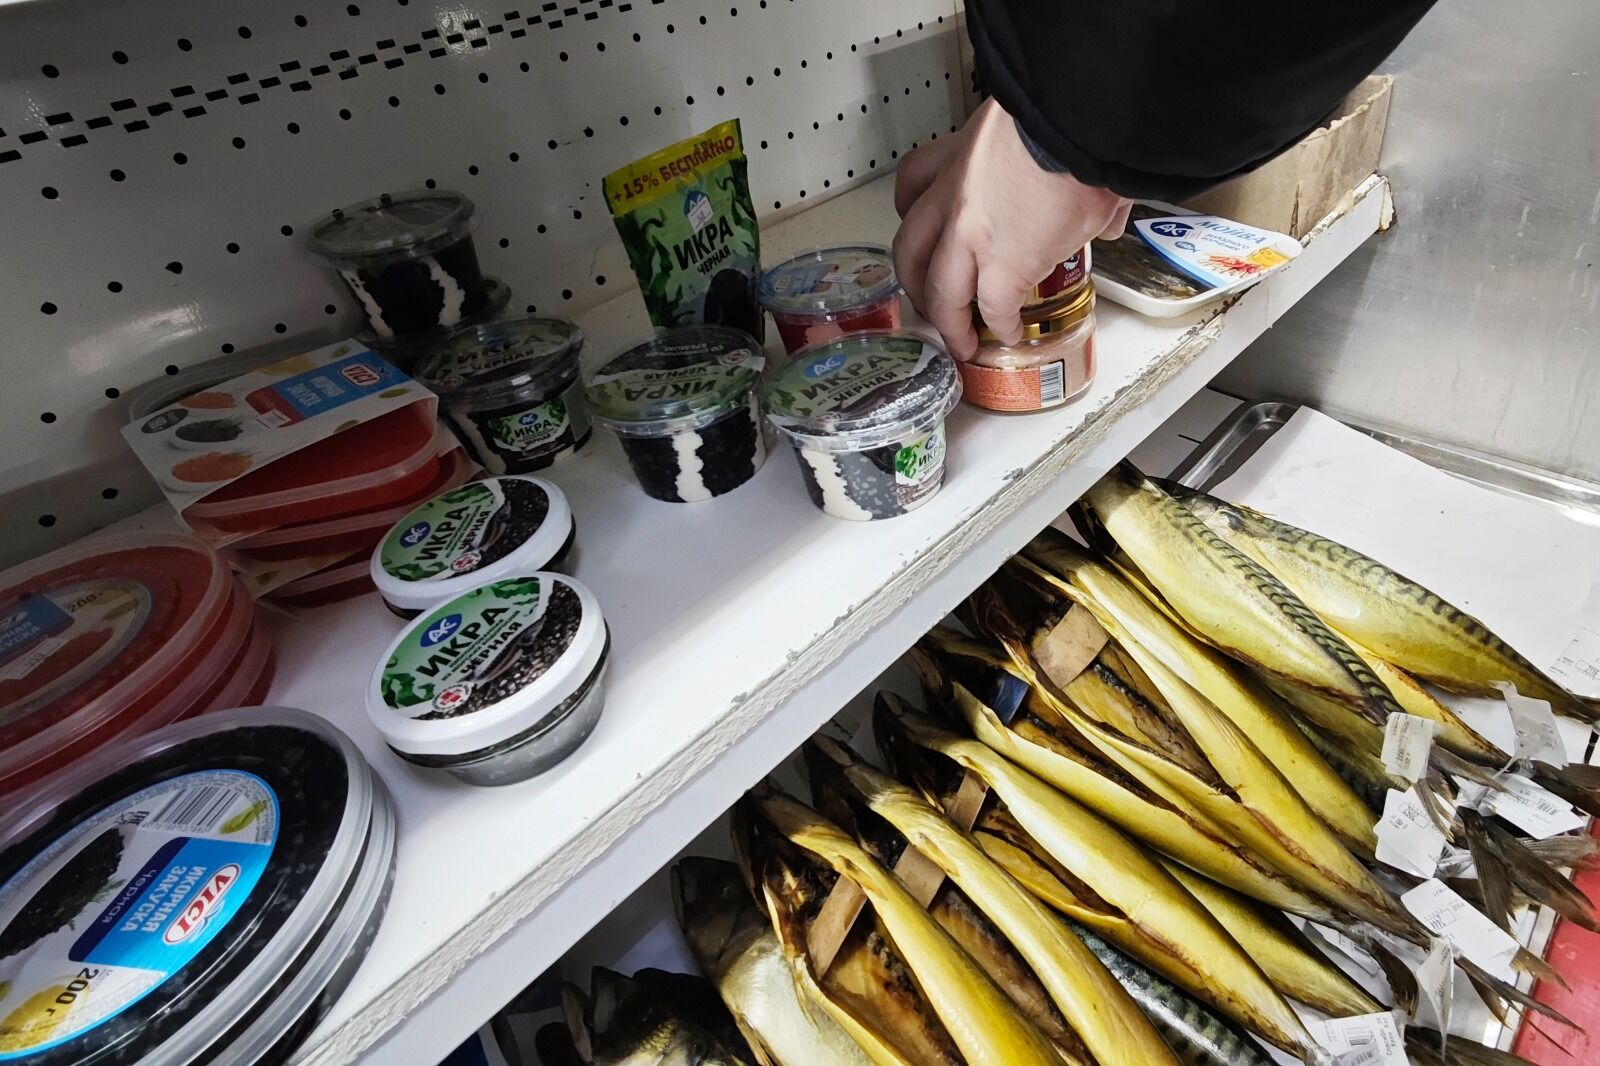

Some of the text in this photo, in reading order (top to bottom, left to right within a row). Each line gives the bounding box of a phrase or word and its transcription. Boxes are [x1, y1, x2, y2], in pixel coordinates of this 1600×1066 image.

[613, 135, 735, 203] +15% БЕСПЛАТНО
[673, 215, 734, 271] ИКРА
[697, 245, 732, 275] ЧЕРНАЯ
[624, 379, 717, 402] ИКРА
[800, 354, 893, 400] ИКРА
[834, 371, 897, 403] ЧЕРНАЯ
[514, 419, 553, 439] ИКРА
[414, 505, 470, 562] ИКРА
[458, 510, 492, 552] ЧЕРНАЯ
[416, 607, 510, 678] ИКРА
[459, 622, 523, 675] ЧЕРНАЯ
[120, 866, 188, 932] ЗАКУСКА
[141, 866, 207, 933] ИКОРНАЯ
[181, 872, 232, 935] VICI
[56, 967, 99, 1004] 200
[45, 1007, 56, 1017] г
